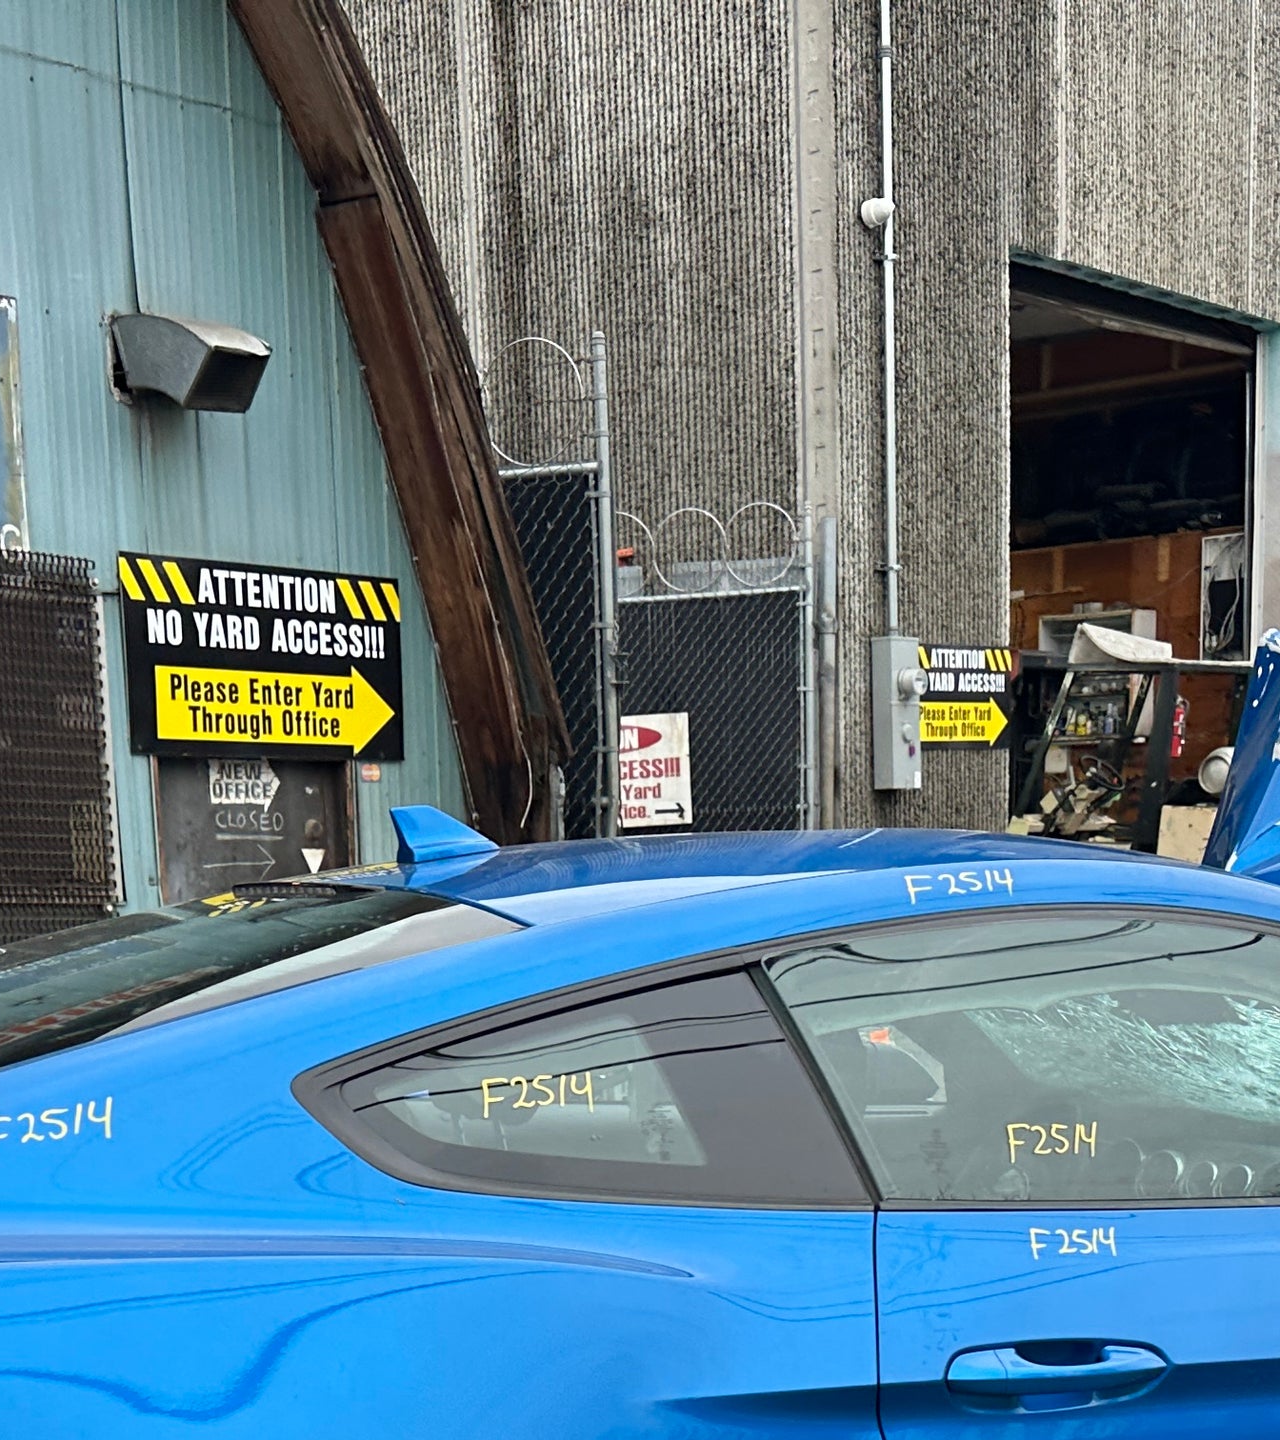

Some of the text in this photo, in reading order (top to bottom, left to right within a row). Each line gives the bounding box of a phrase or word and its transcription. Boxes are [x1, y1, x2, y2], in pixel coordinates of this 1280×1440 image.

[197, 567, 336, 614] ATTENTION
[146, 608, 386, 659] NO YARD ACCESS!!!
[930, 648, 986, 669] ATTENTION
[170, 673, 354, 709] Please Enter Yard
[928, 672, 1005, 692] YARD ACCESS!!!
[189, 706, 340, 740] Through Office
[926, 722, 985, 739] Through Office
[949, 706, 971, 721] Enter
[974, 706, 992, 721] Yard
[219, 761, 261, 780] NEW
[213, 781, 273, 800] OFFICE
[623, 783, 661, 800] Yard
[904, 868, 1013, 905] F2514
[481, 1071, 594, 1119] F2514
[1006, 1121, 1097, 1164] F2514
[1029, 1226, 1117, 1260] F2514
